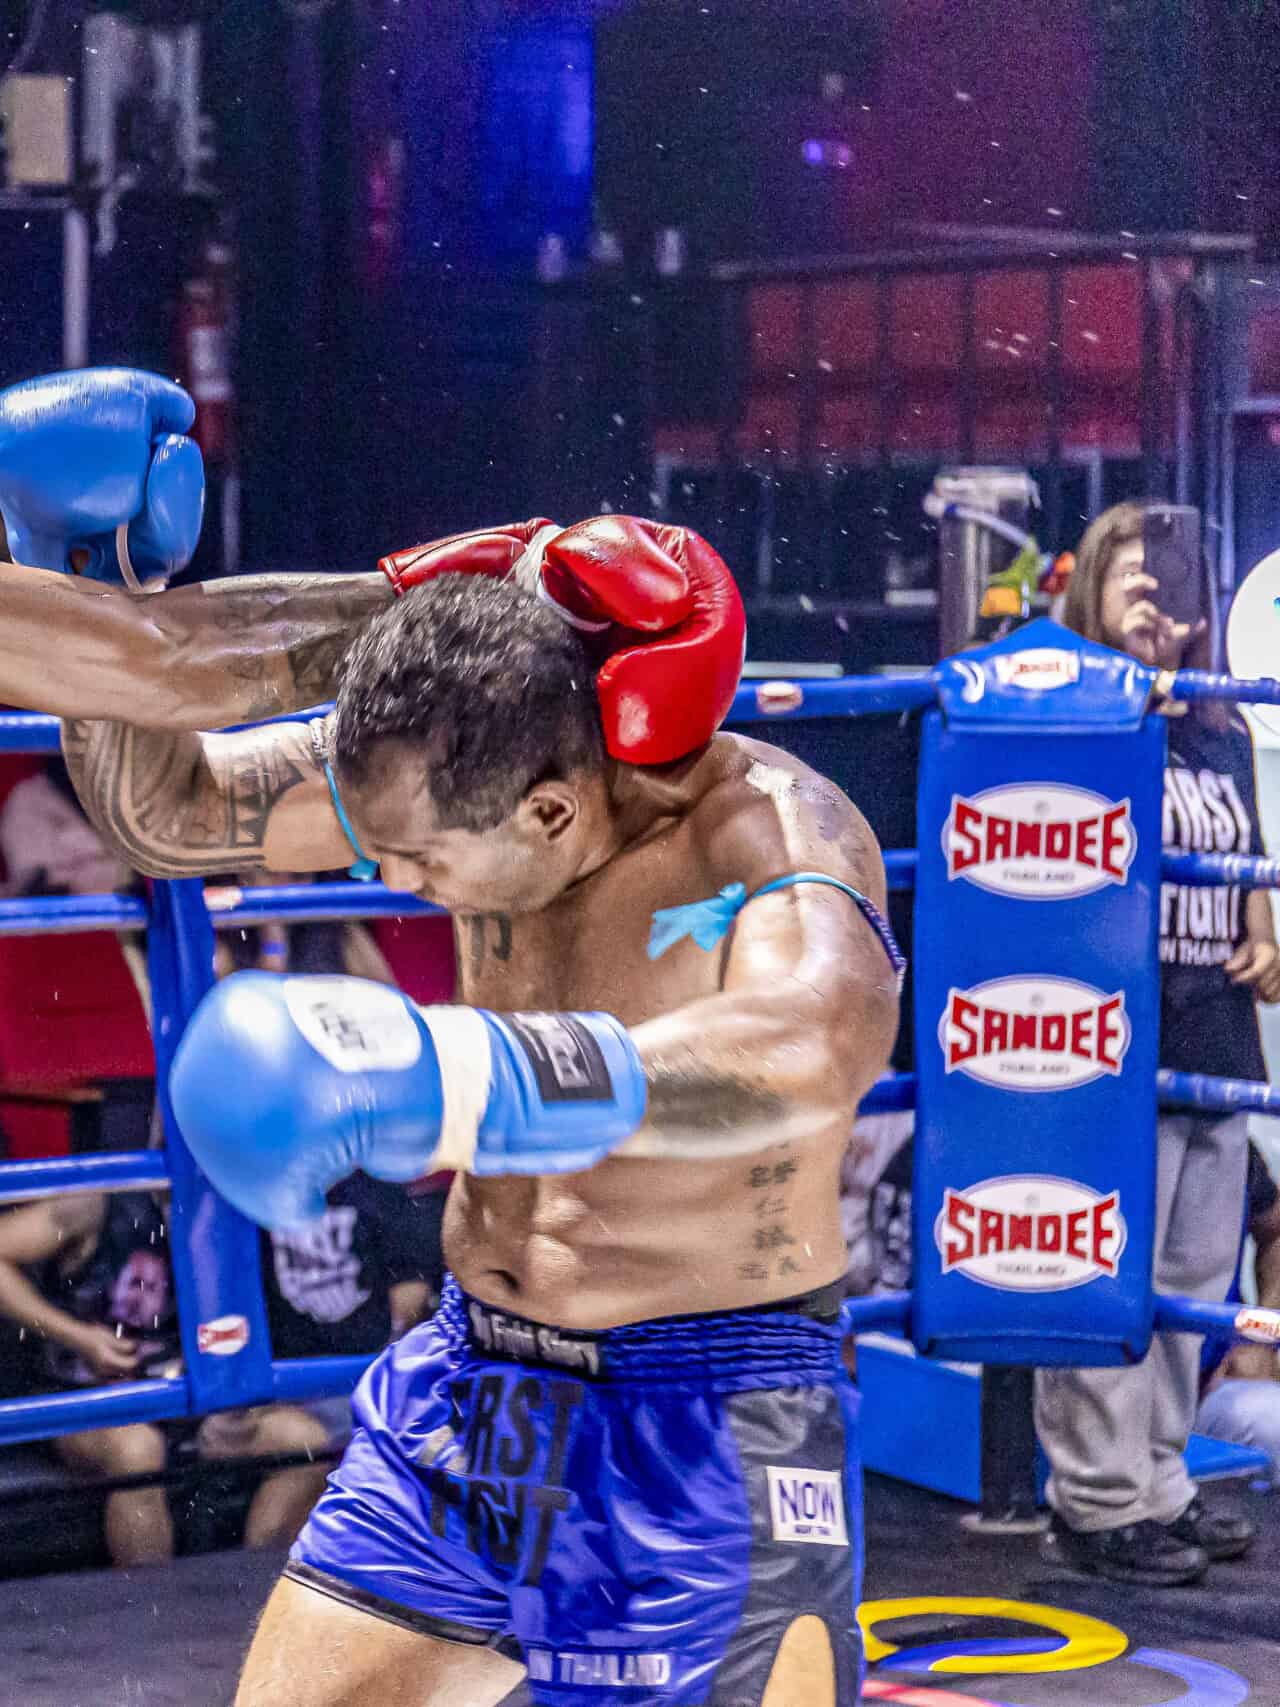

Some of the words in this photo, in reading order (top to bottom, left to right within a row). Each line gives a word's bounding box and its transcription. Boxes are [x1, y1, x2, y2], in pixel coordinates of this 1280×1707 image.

[953, 802, 1127, 877] SANDEE
[950, 995, 1121, 1067] SANDEE
[947, 1196, 1116, 1269] SANDEE
[777, 1479, 837, 1525] NOW
